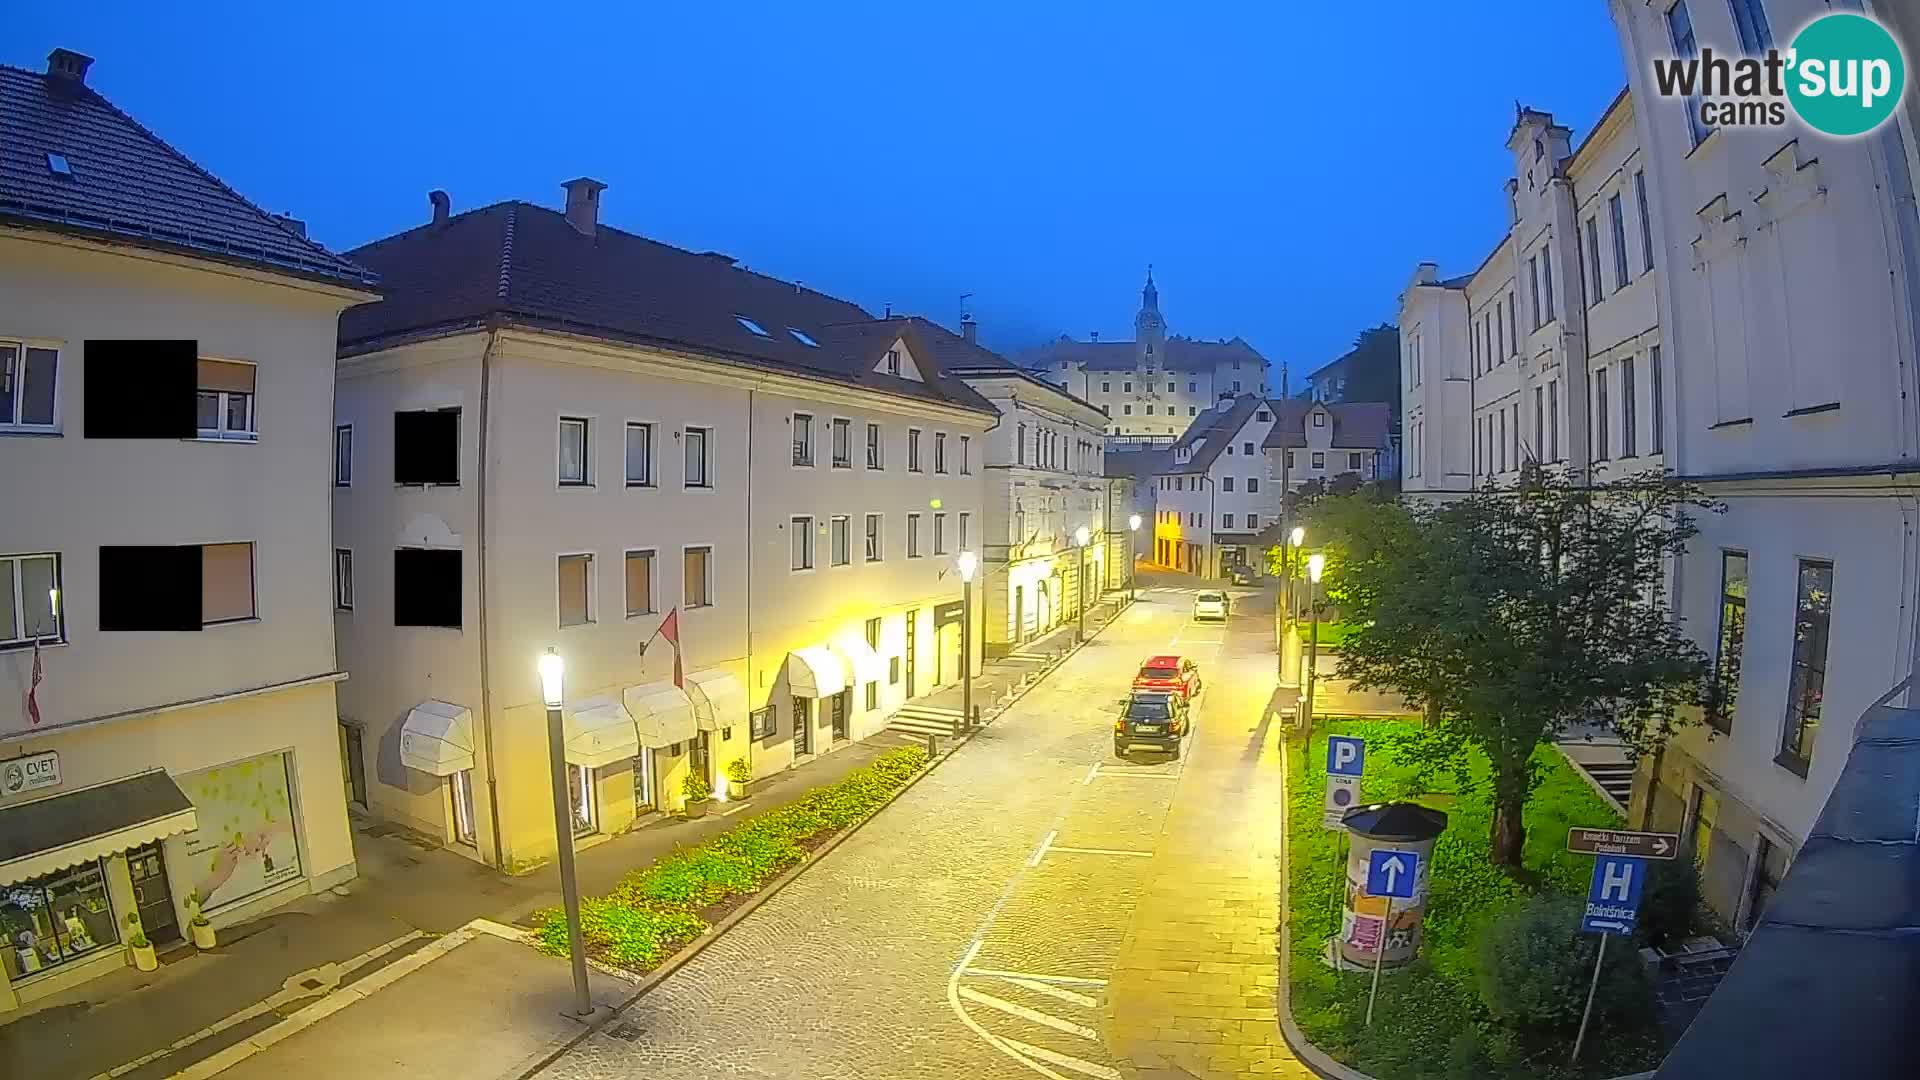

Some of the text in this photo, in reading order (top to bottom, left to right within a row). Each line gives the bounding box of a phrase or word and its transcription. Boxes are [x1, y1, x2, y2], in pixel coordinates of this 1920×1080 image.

[26, 758, 55, 775] CVET
[1335, 741, 1356, 770] P
[1601, 862, 1633, 901] H
